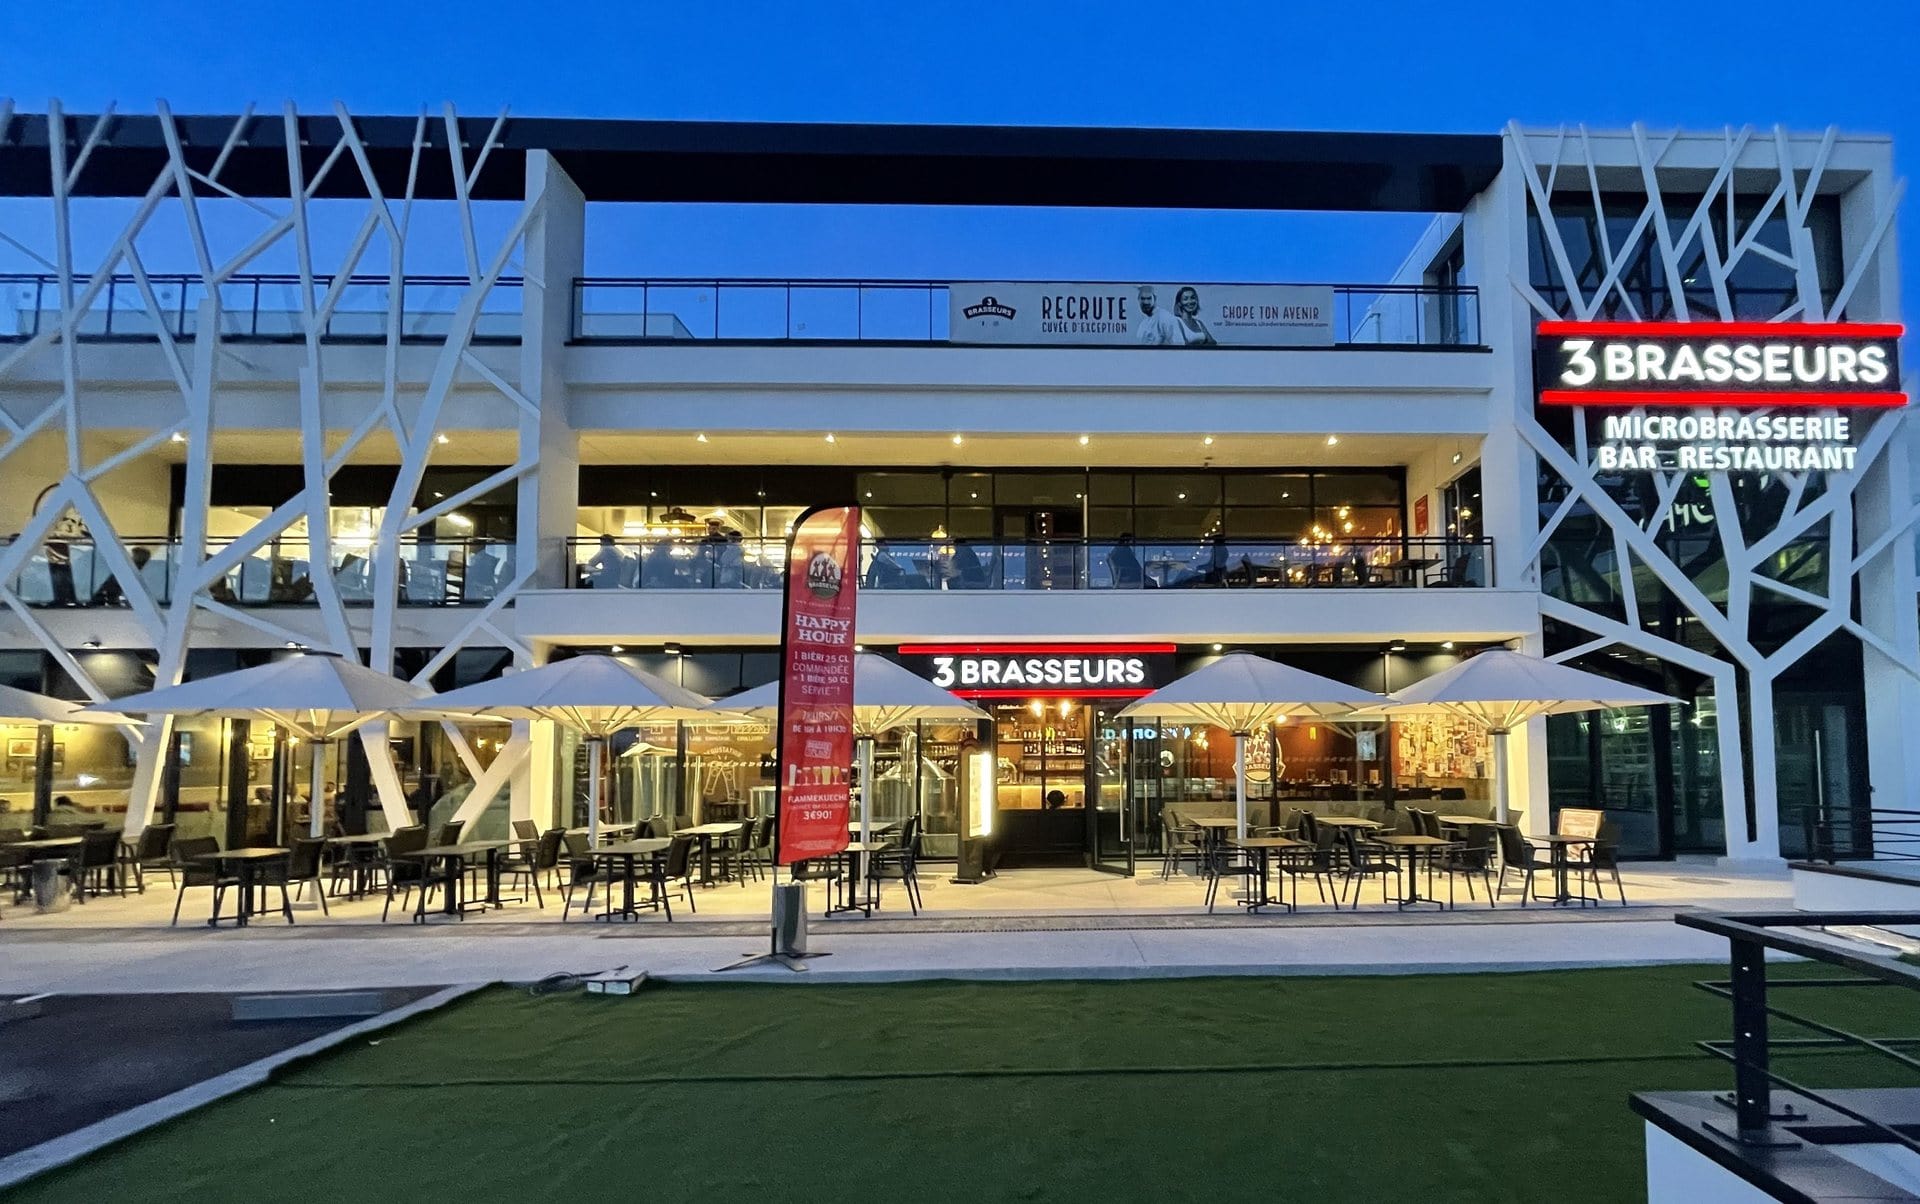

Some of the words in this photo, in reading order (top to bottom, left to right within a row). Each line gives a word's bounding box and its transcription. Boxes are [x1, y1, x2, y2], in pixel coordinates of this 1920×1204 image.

[967, 306, 1012, 317] BRASSEURS
[1042, 296, 1127, 320] RECRUTE
[1222, 305, 1255, 320] CHOPE
[1260, 306, 1279, 320] TON
[1283, 306, 1320, 320] AVENIR
[1042, 320, 1069, 333] CUVÉE
[1072, 321, 1127, 333] D'EXCEPTION
[1560, 339, 1597, 386] 3
[1603, 343, 1889, 383] BRASSEURS
[1605, 415, 1849, 440] MICROBRASSERIE
[1600, 446, 1657, 470] BAR
[1680, 446, 1858, 471] RESTAURANT
[795, 614, 851, 631] HAPPY
[931, 656, 956, 687] 3
[960, 657, 1145, 685] BRASSEURS
